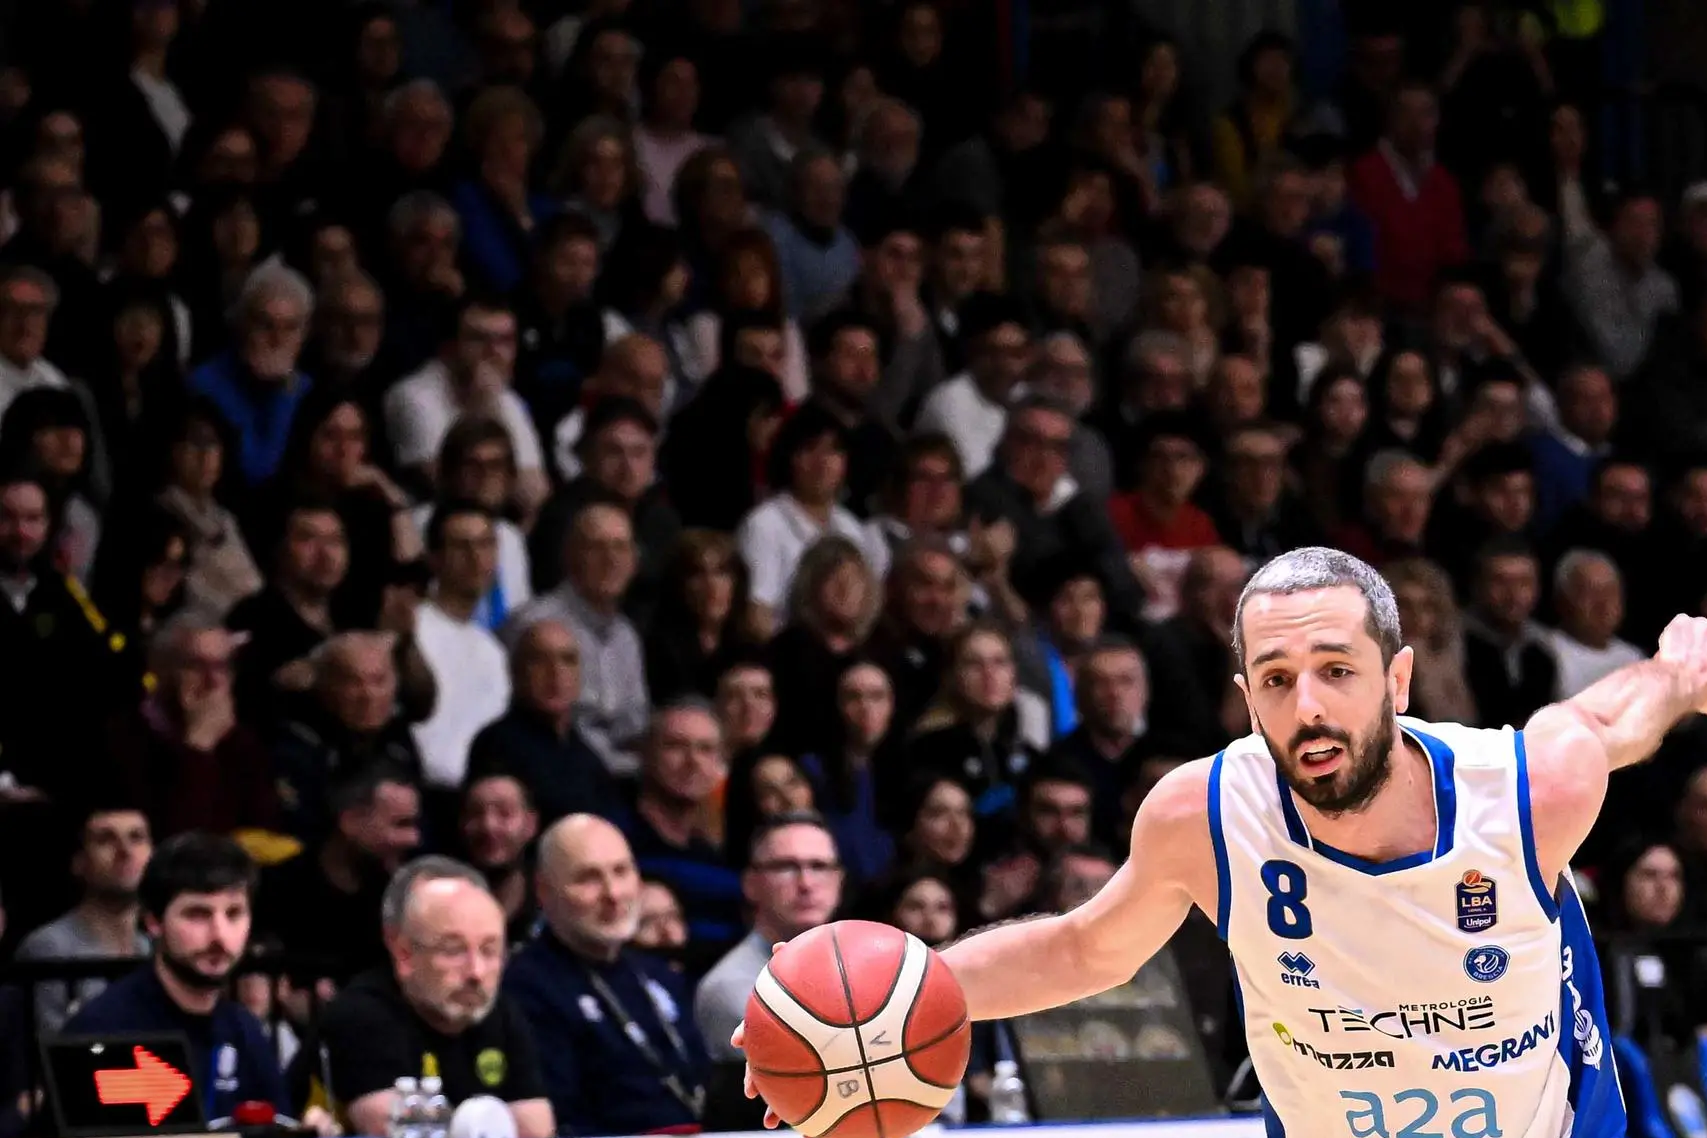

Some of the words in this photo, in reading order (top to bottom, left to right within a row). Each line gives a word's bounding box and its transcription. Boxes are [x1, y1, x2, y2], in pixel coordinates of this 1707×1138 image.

[1260, 859, 1313, 940] 8
[1461, 895, 1492, 908] LBA
[1308, 1003, 1496, 1039] TECHNE
[1398, 995, 1493, 1012] METROLOGIA
[1431, 1010, 1556, 1072] MEGRANI
